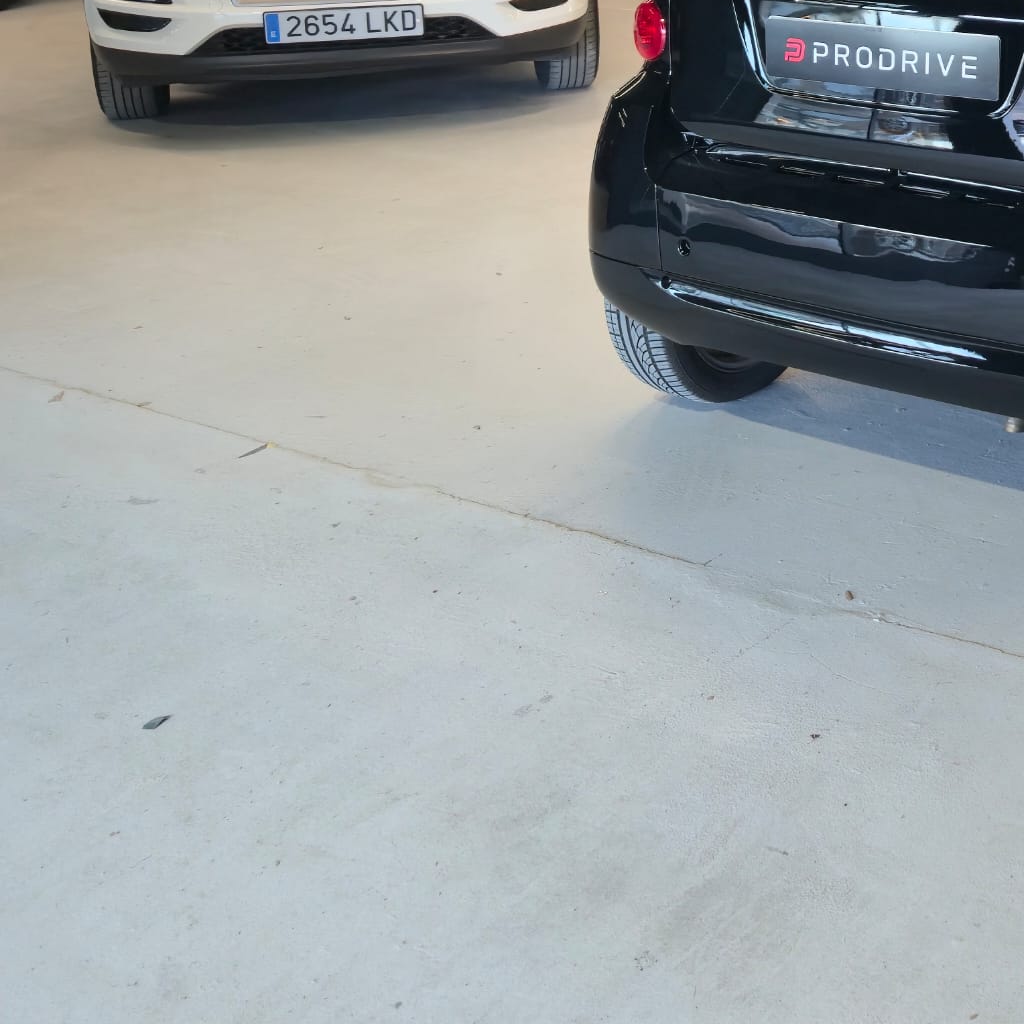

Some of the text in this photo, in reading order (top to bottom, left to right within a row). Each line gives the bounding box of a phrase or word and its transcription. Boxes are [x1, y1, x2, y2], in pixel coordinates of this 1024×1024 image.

[286, 9, 417, 38] 2654 LKD
[812, 41, 978, 80] PRODRIVE
